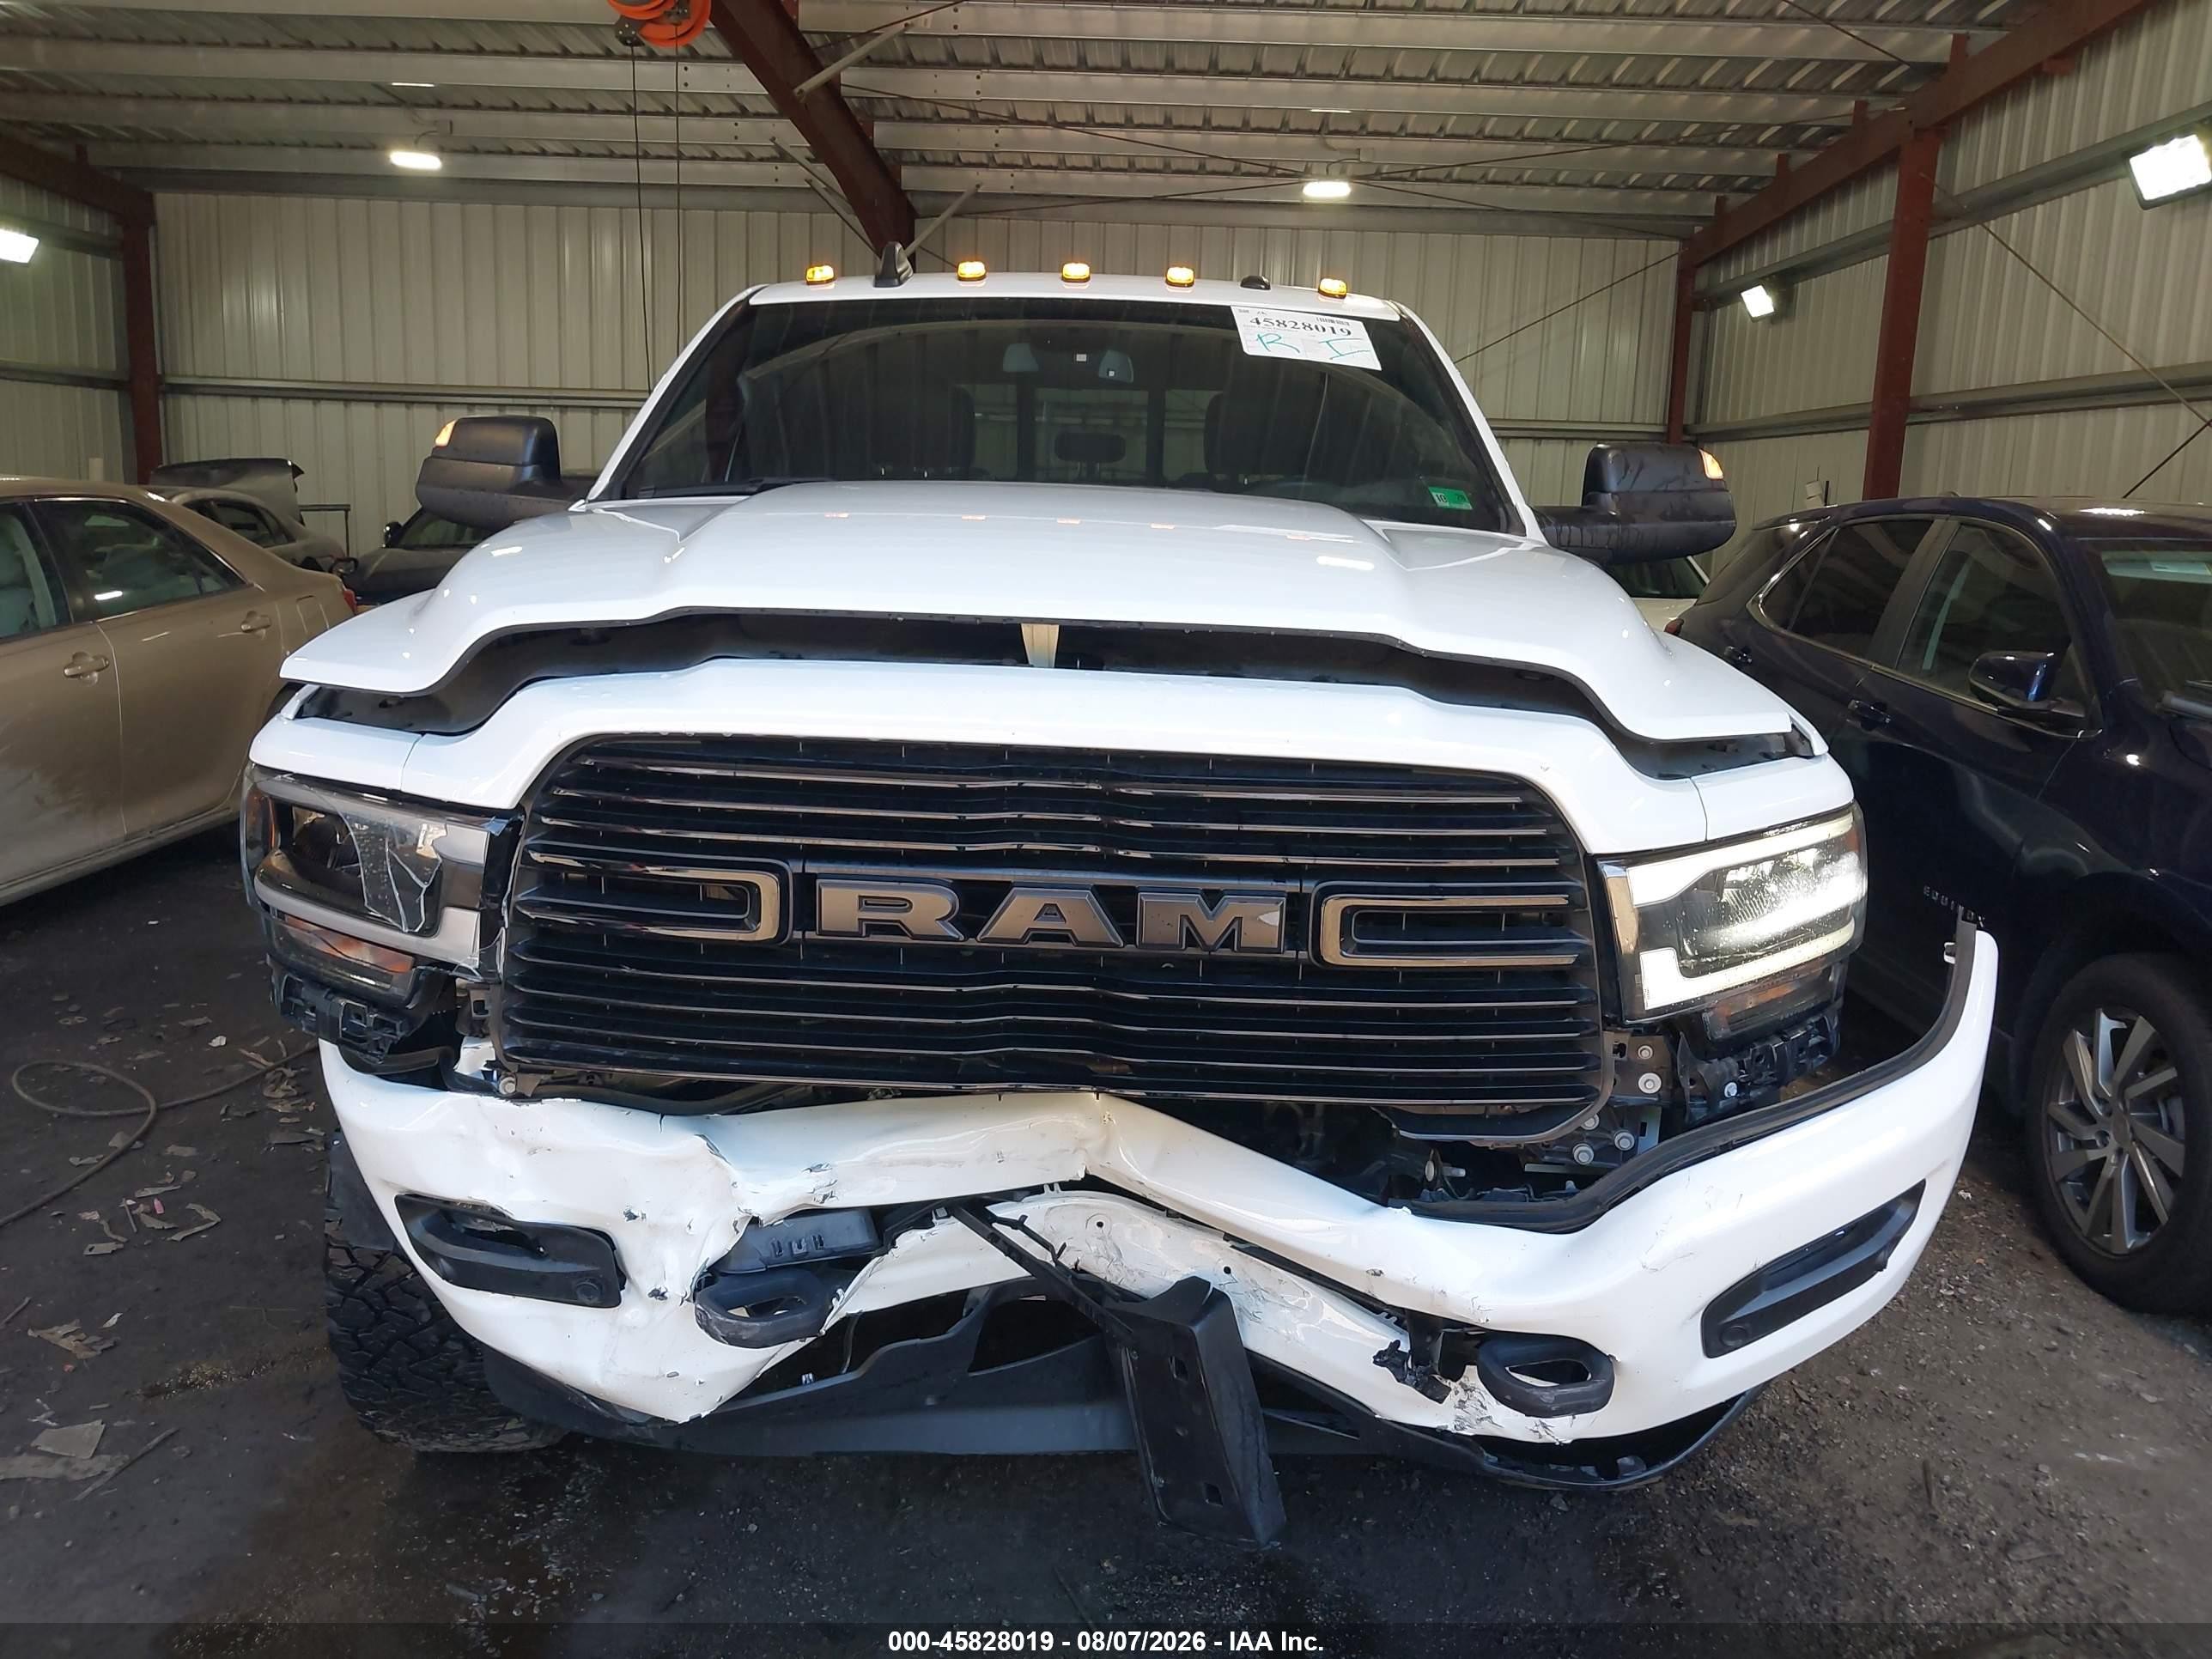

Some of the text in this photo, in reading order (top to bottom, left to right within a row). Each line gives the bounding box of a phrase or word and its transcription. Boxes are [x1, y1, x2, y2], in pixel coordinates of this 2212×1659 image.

[1249, 317, 1352, 337] 45828019
[816, 877, 1286, 954] RAM
[1923, 884, 1985, 928] EQUIOX
